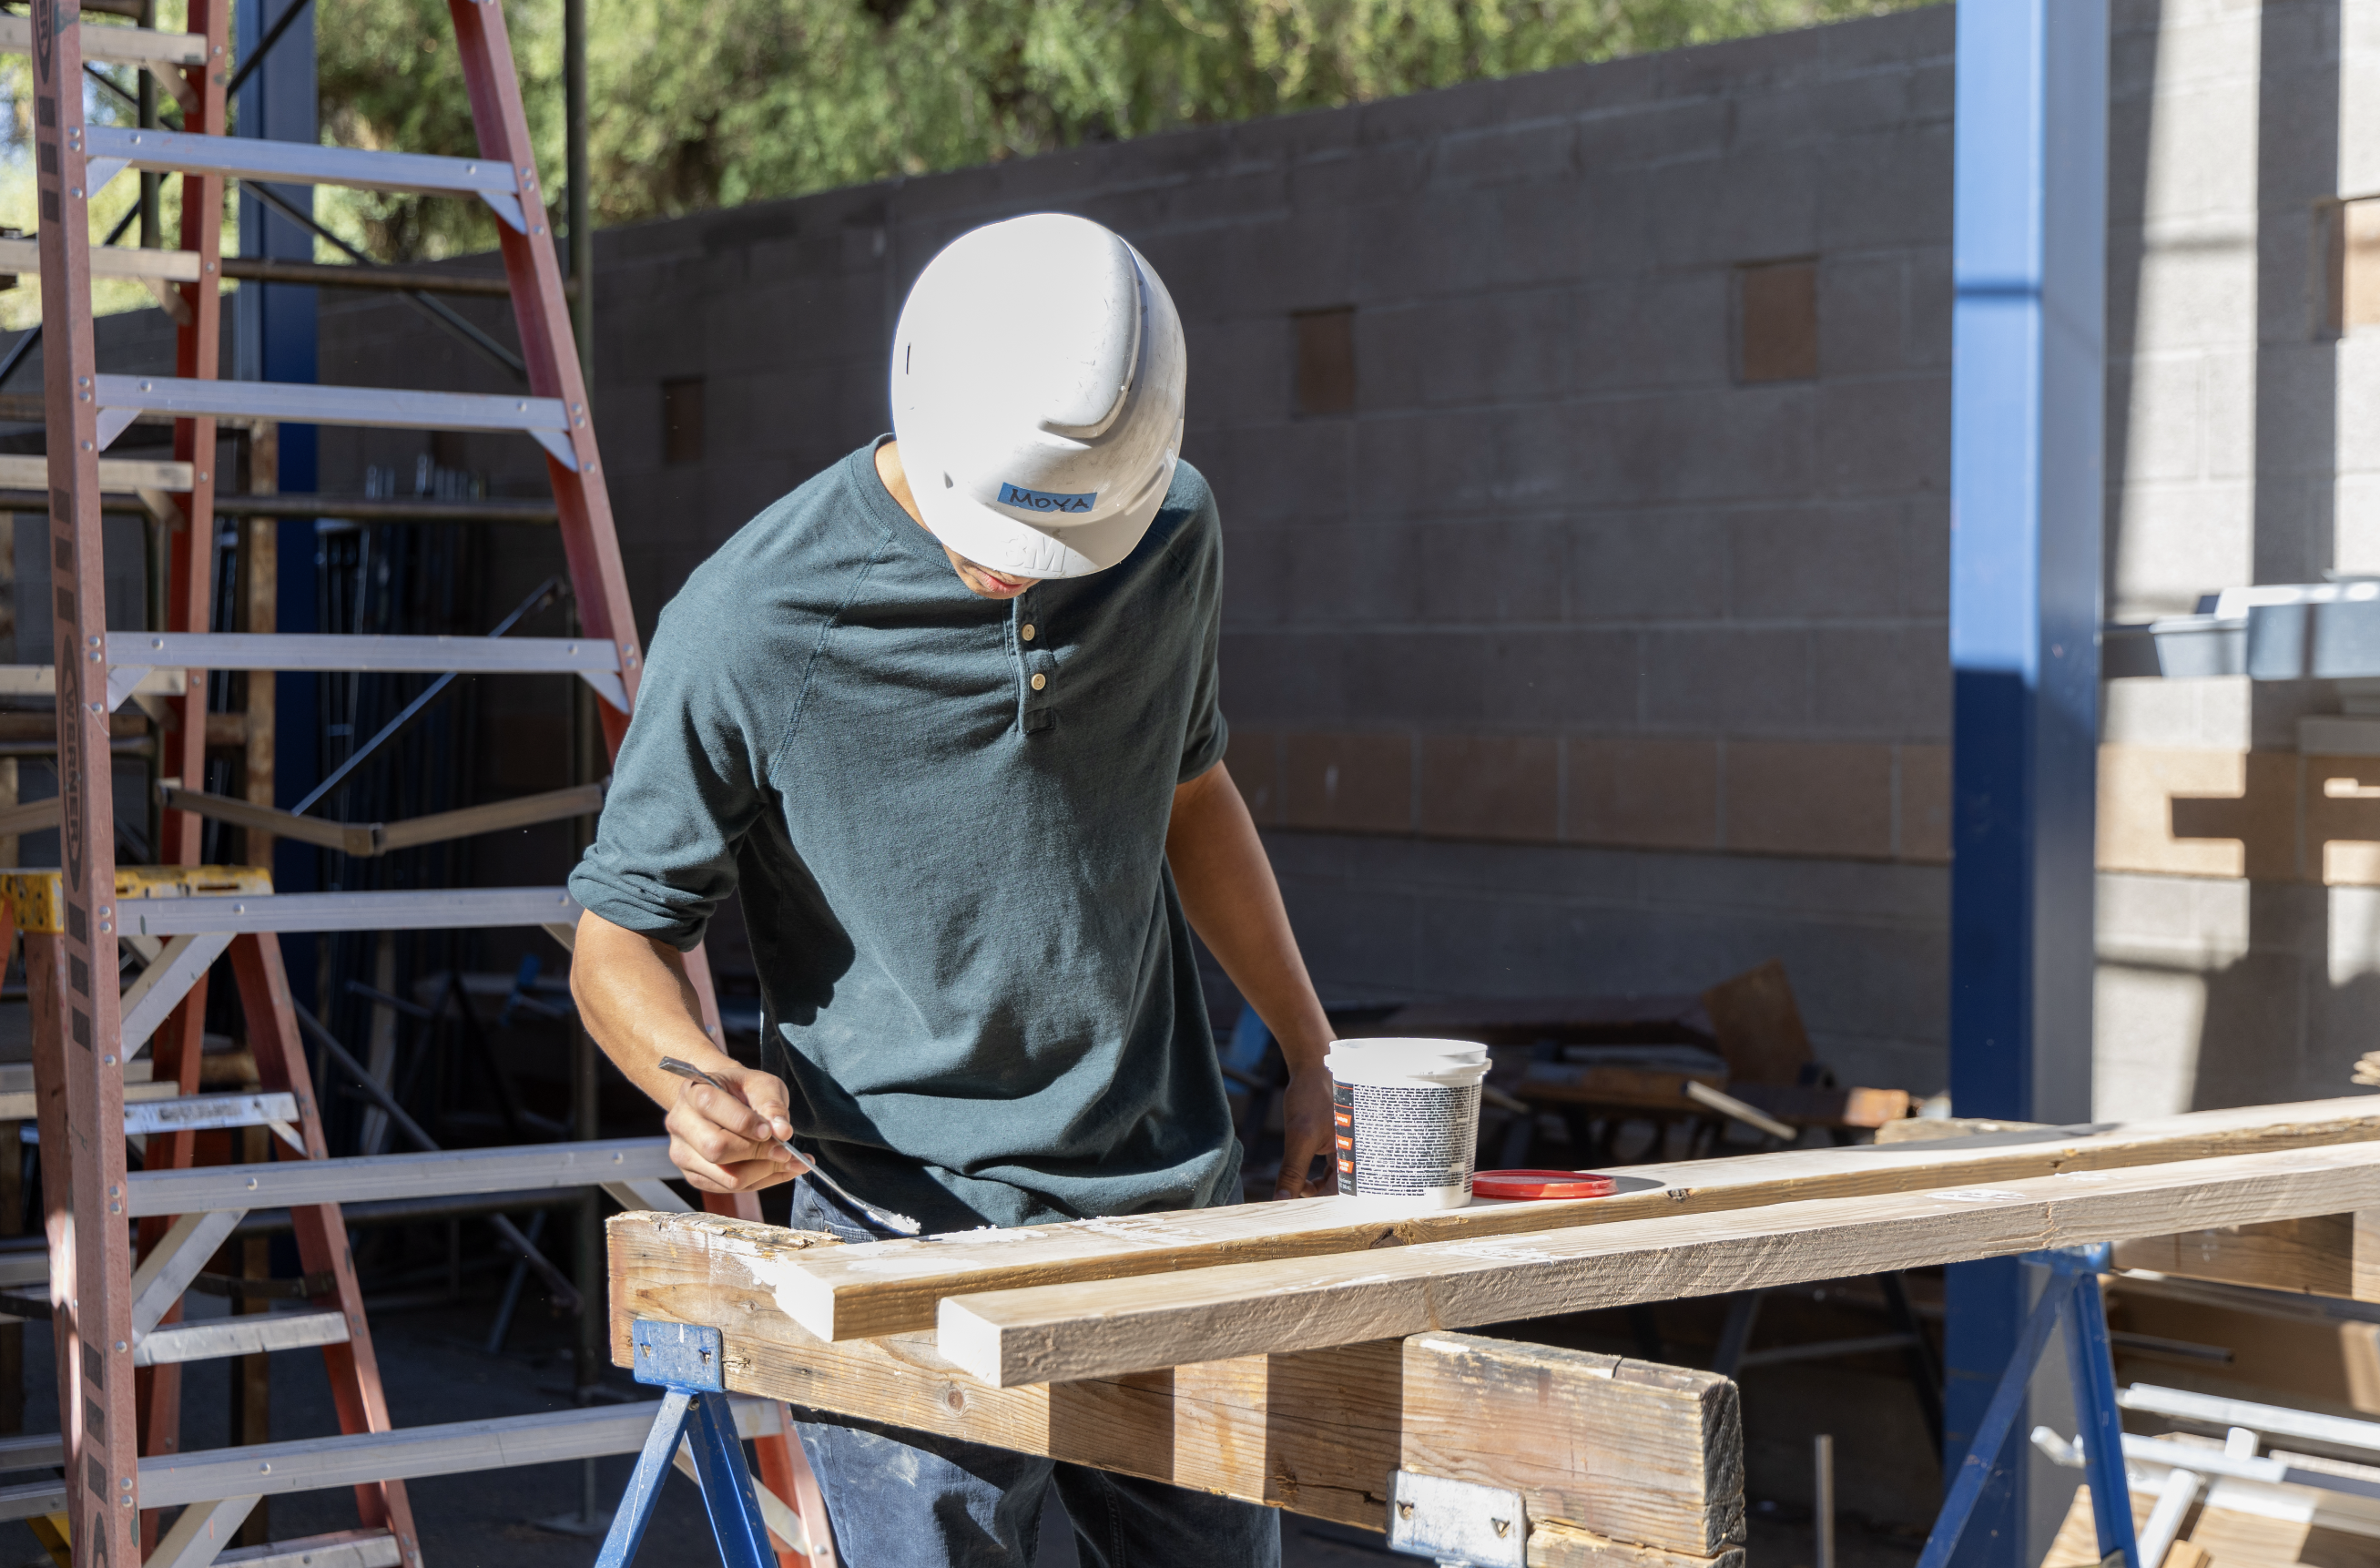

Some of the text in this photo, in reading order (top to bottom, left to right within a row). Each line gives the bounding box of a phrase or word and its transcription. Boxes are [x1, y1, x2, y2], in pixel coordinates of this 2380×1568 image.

[1010, 488, 1089, 512] MOYA
[1001, 533, 1066, 573] 3M
[66, 687, 78, 842] WERNER
